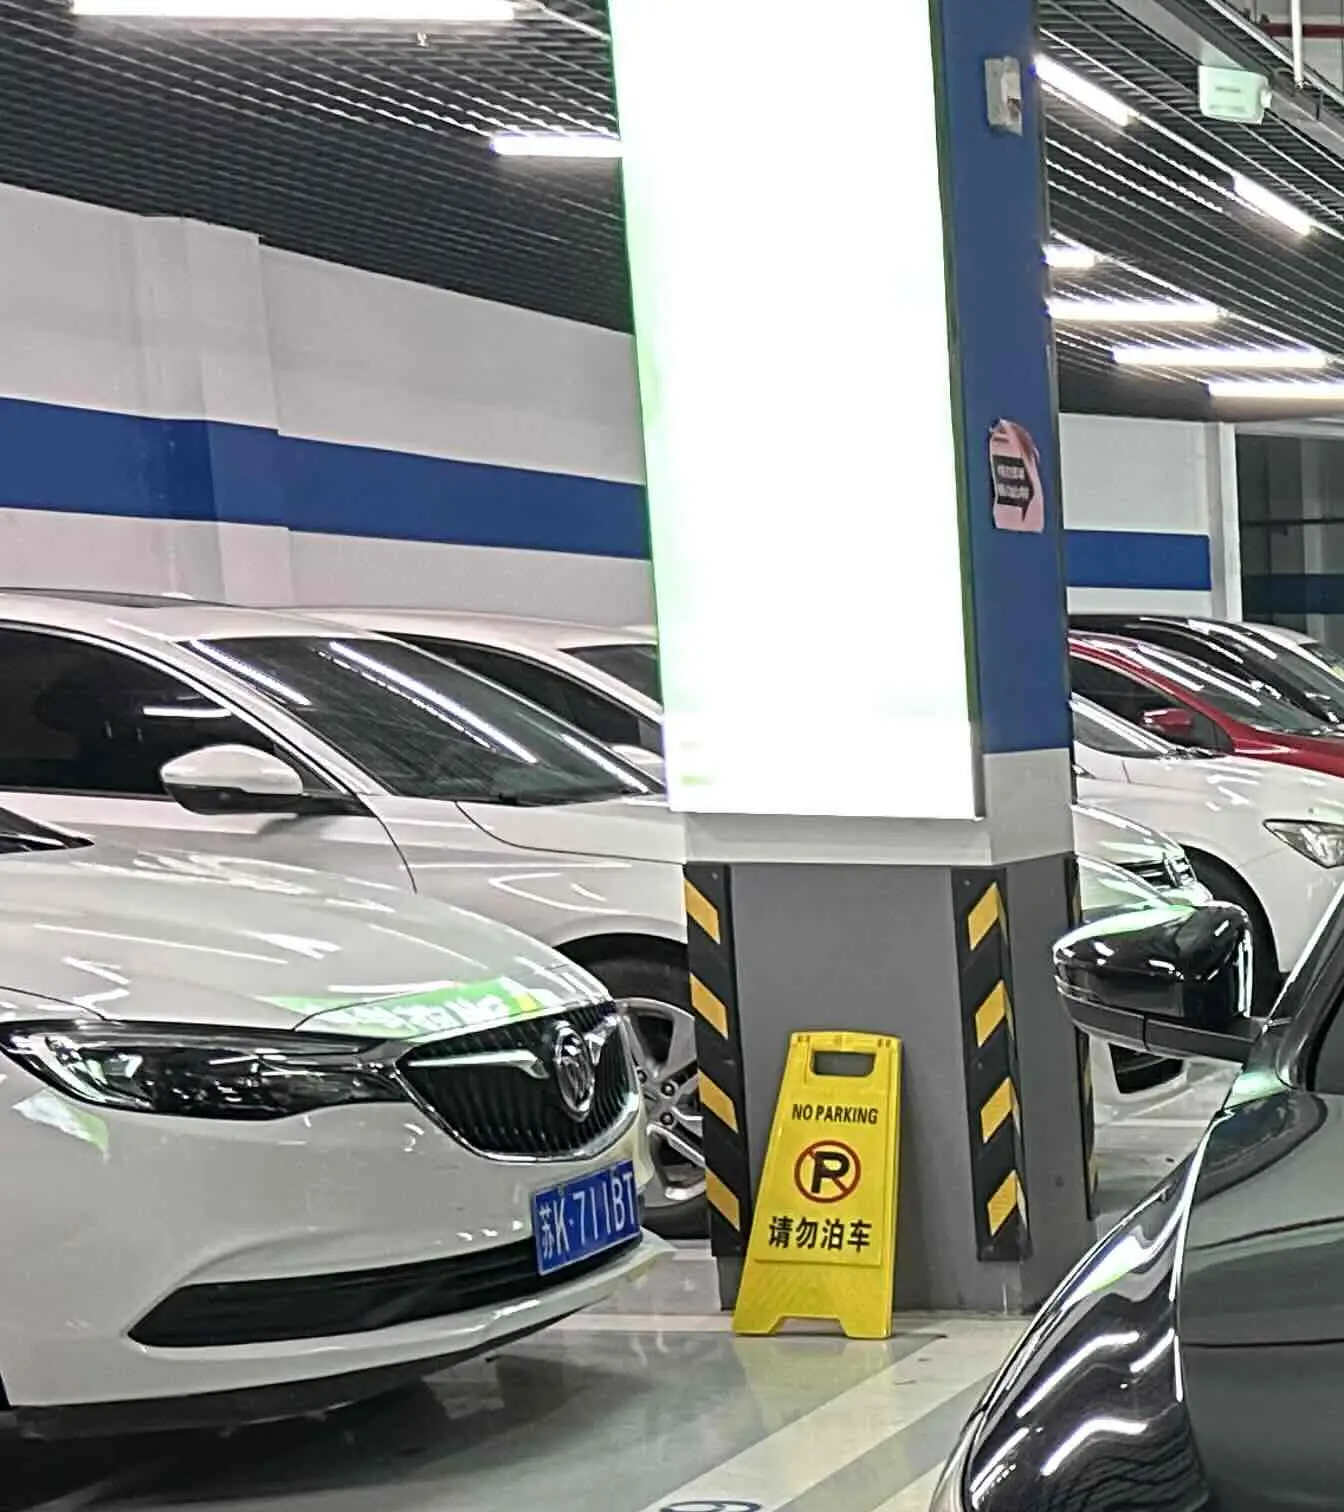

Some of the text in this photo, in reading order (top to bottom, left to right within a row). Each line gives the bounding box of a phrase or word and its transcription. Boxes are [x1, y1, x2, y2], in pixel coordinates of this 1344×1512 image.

[791, 1103, 879, 1125] NO PARKING
[768, 1216, 873, 1253] 请勿泊车
